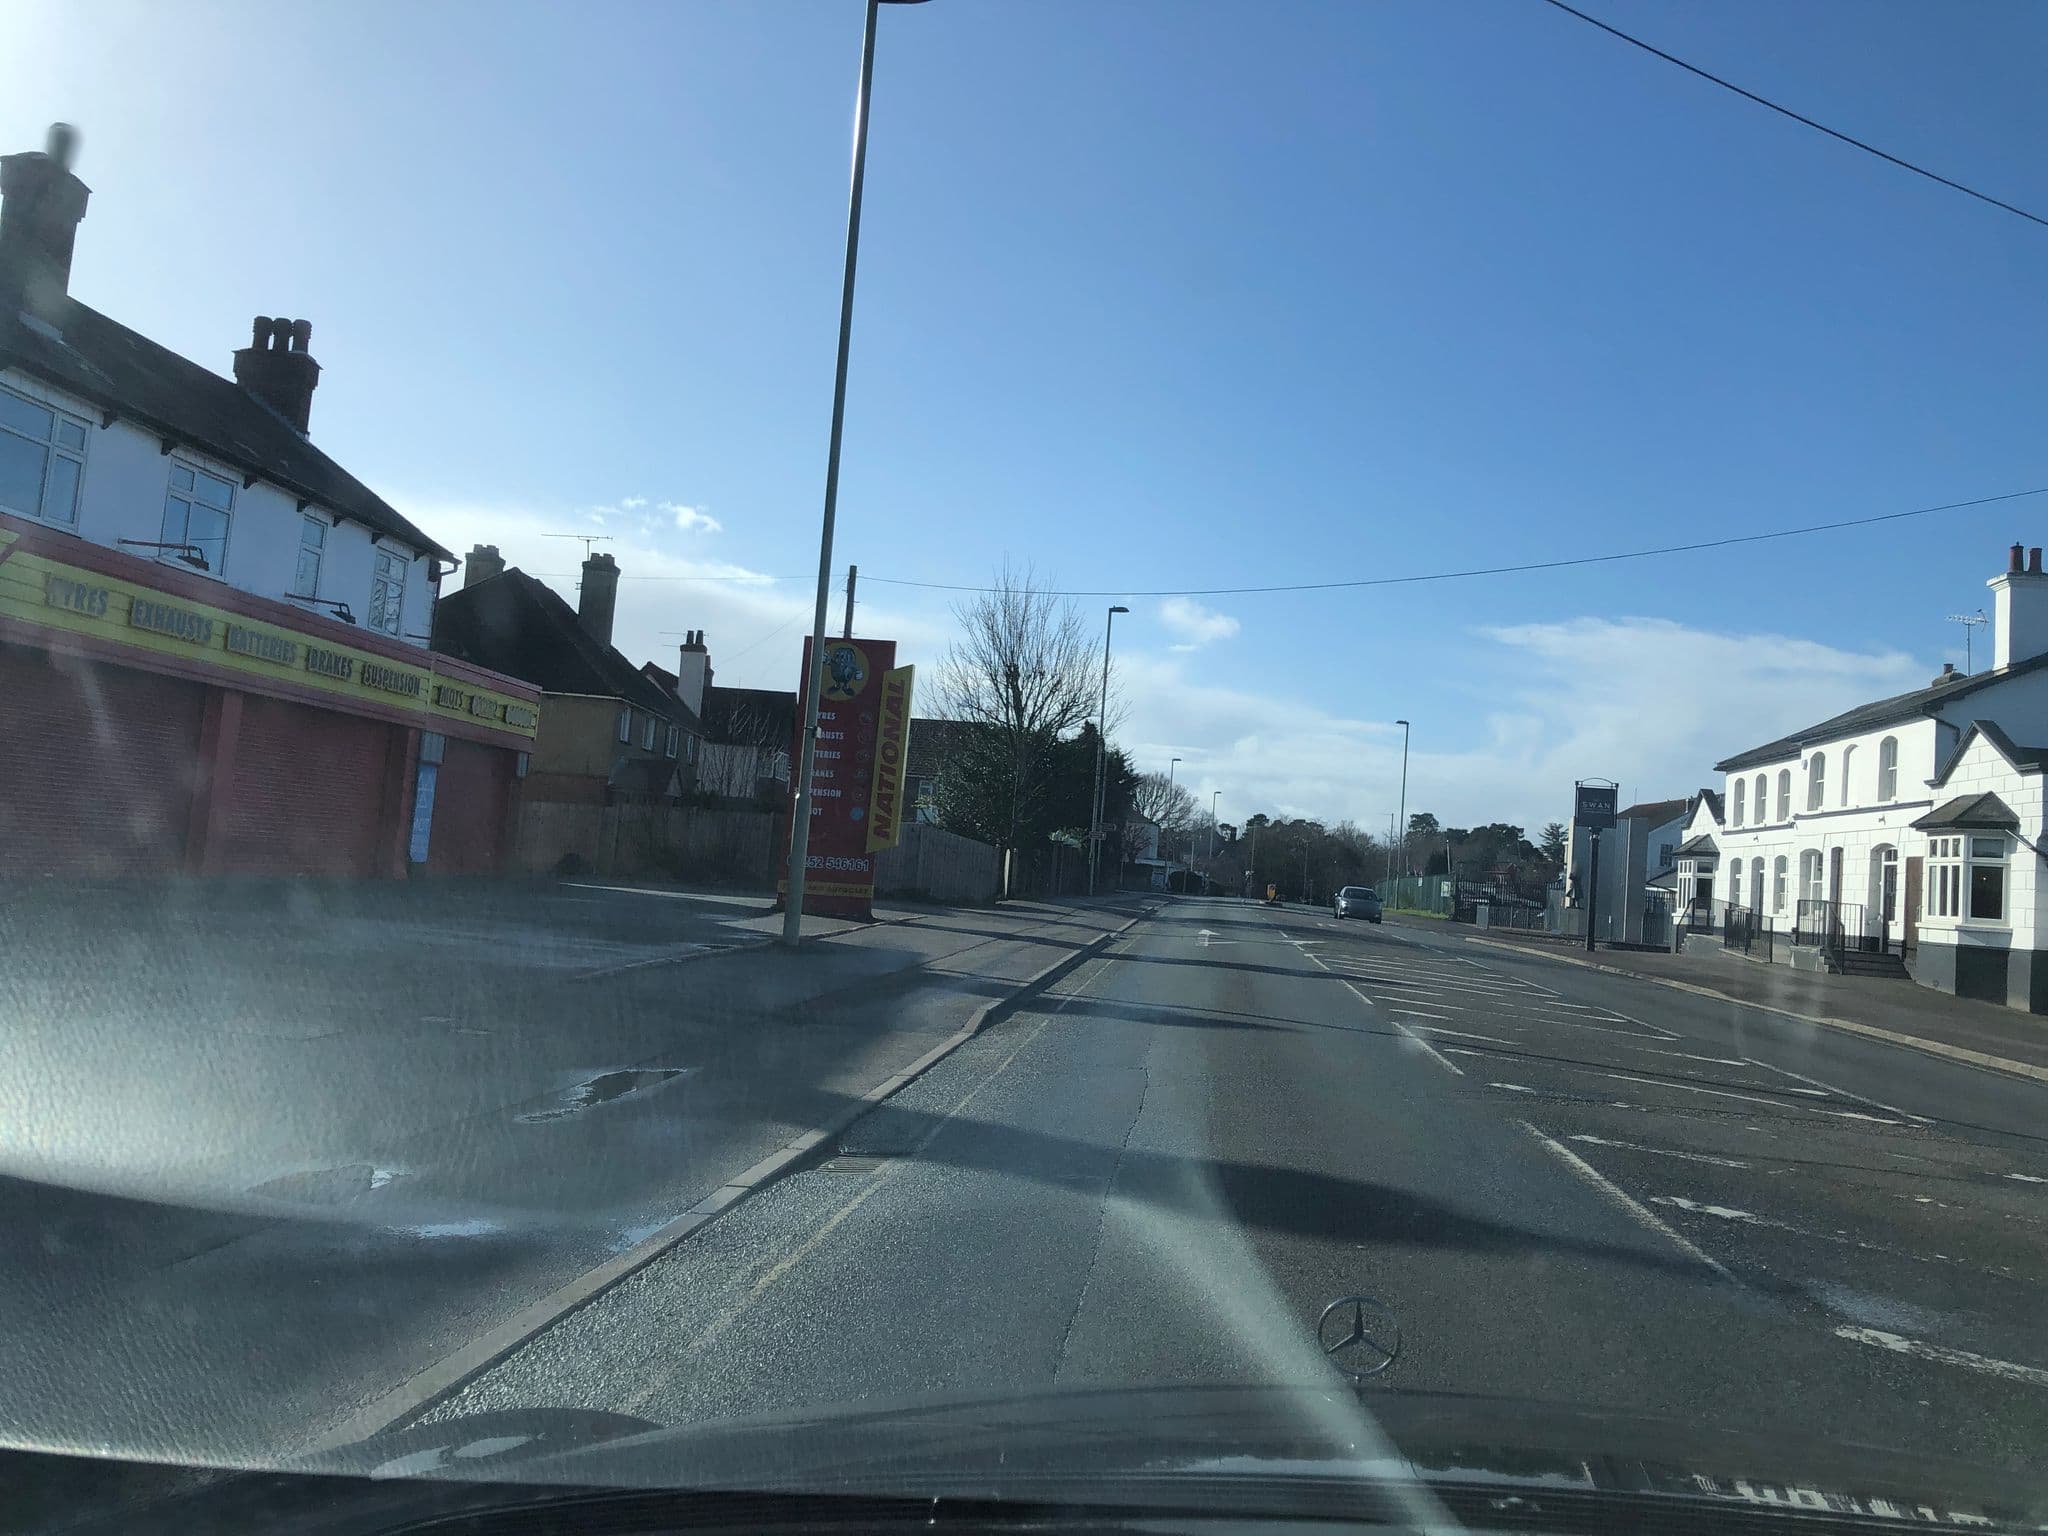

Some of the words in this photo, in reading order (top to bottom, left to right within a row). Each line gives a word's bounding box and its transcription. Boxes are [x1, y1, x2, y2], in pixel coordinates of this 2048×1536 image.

[47, 575, 108, 616] TYRES
[131, 598, 213, 642] EXHAUSTS
[229, 624, 297, 664] BATTERIES
[309, 648, 353, 680] BRAKES
[364, 663, 421, 696] SUSPENSION
[816, 711, 836, 720] YRES
[821, 729, 844, 739] AUSTS
[815, 750, 841, 759] TERIES
[873, 679, 906, 841] NATIONAL
[811, 769, 834, 777] RAKES
[809, 787, 842, 798] PENSION
[1582, 801, 1611, 809] SWAN
[826, 857, 869, 872] 546161
